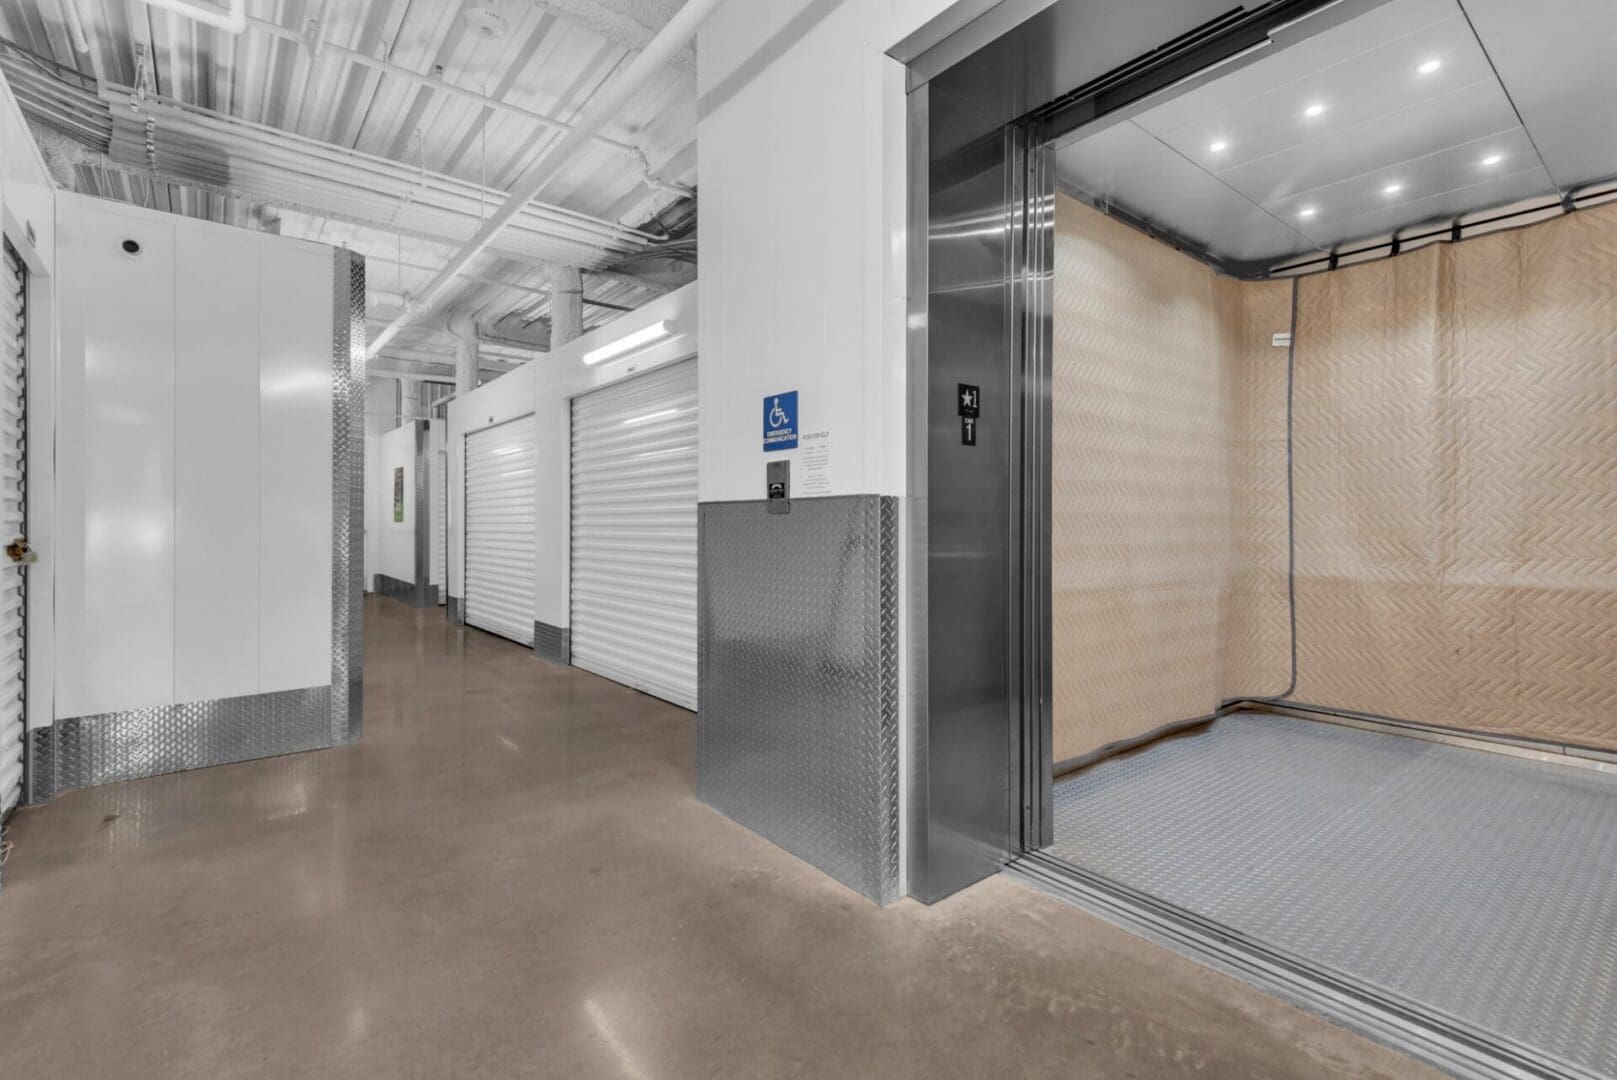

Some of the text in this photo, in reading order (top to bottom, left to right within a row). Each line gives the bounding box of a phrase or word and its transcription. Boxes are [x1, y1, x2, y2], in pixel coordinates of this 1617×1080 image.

[972, 390, 978, 408] 1
[764, 434, 798, 443] COMMUNICATION
[767, 429, 792, 438] EMERGENCY
[966, 424, 972, 441] 1
